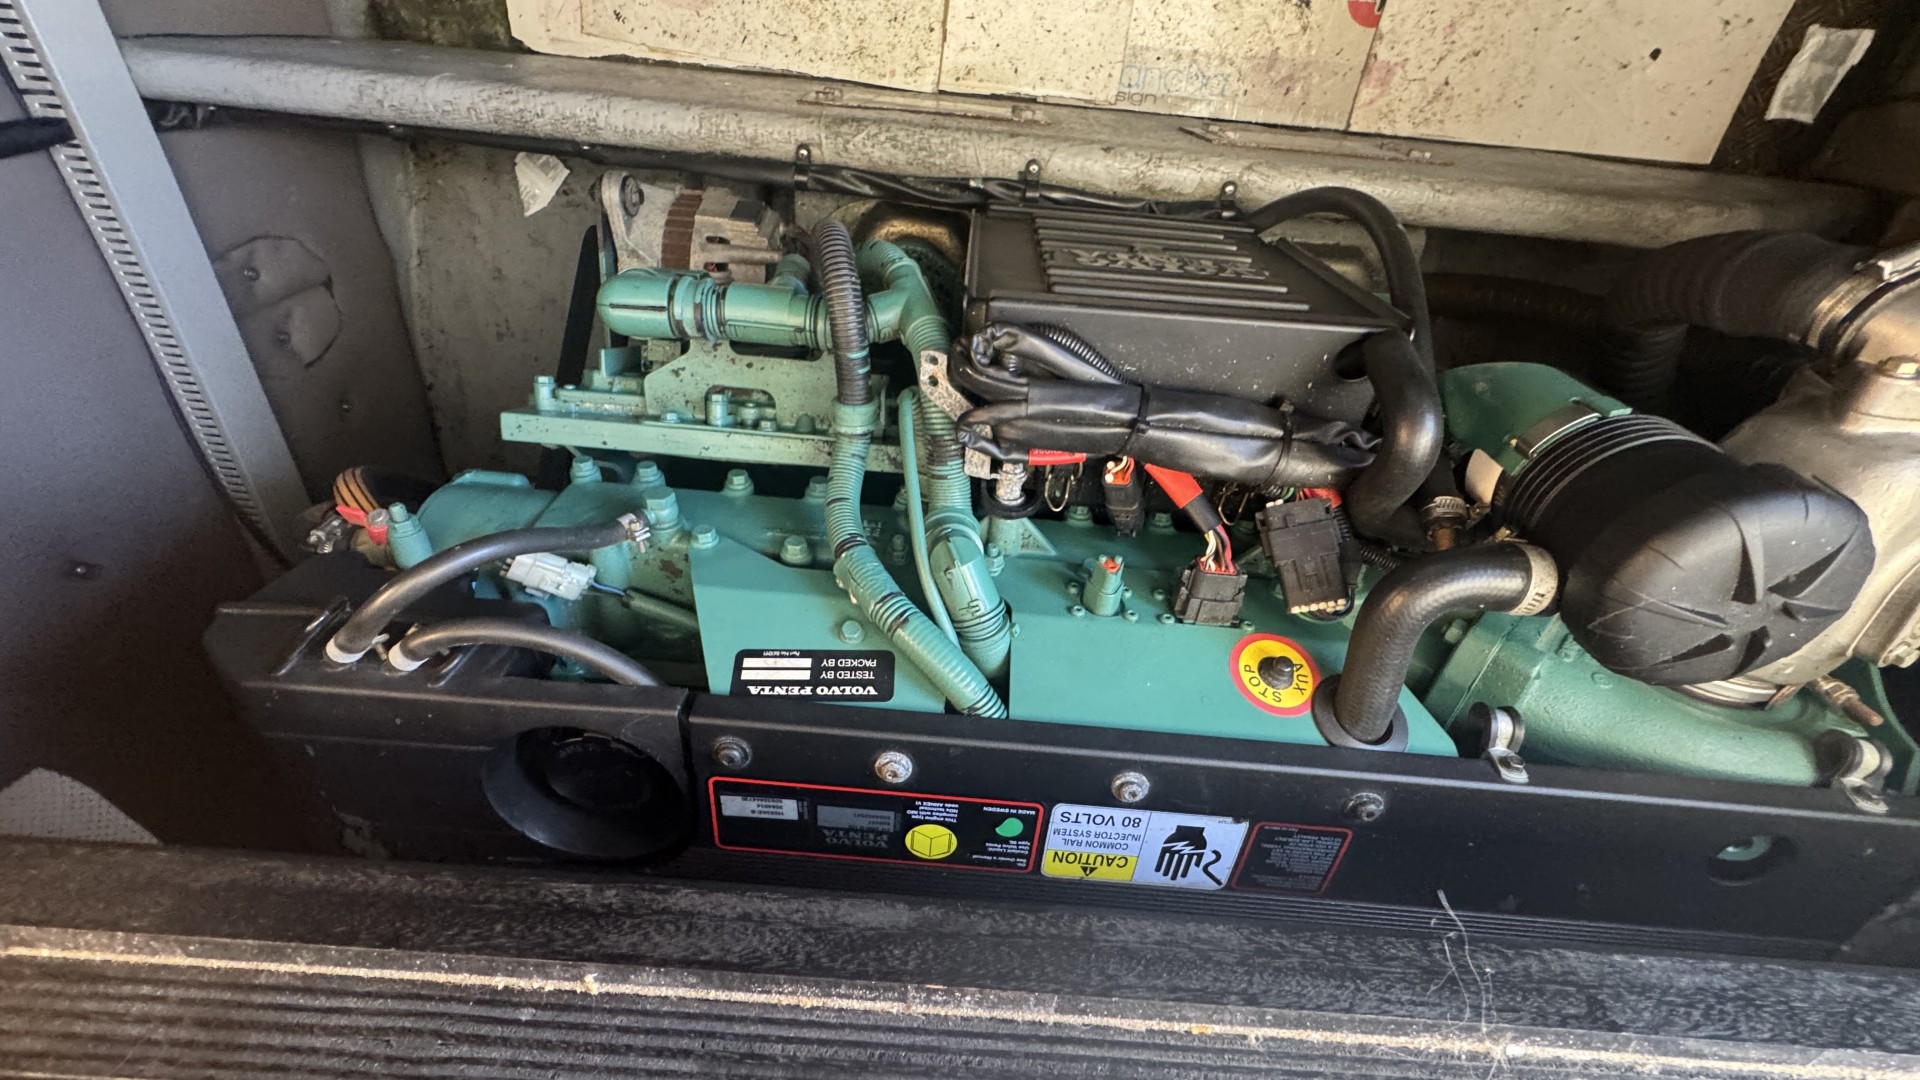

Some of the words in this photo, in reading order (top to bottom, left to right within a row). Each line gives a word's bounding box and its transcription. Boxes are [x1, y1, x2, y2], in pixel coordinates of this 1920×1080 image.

[821, 659, 836, 667] BY
[838, 658, 876, 667] PACKED
[820, 671, 834, 679] BY
[837, 670, 875, 679] TESTED
[1292, 663, 1309, 695] AUX
[1244, 664, 1282, 703] STOP
[747, 685, 813, 695] PENTA
[816, 686, 878, 695] VOLVO
[1060, 811, 1115, 826] VOLTS
[1121, 816, 1142, 827] 80
[822, 830, 889, 841] PENTA
[1053, 828, 1092, 839] SYSTEM
[1094, 830, 1142, 841] INJECTOR
[825, 837, 889, 848] VOLVO
[1062, 838, 1083, 848] RAIL
[1085, 839, 1129, 851] COMMON
[1052, 851, 1129, 868] CAUTION
